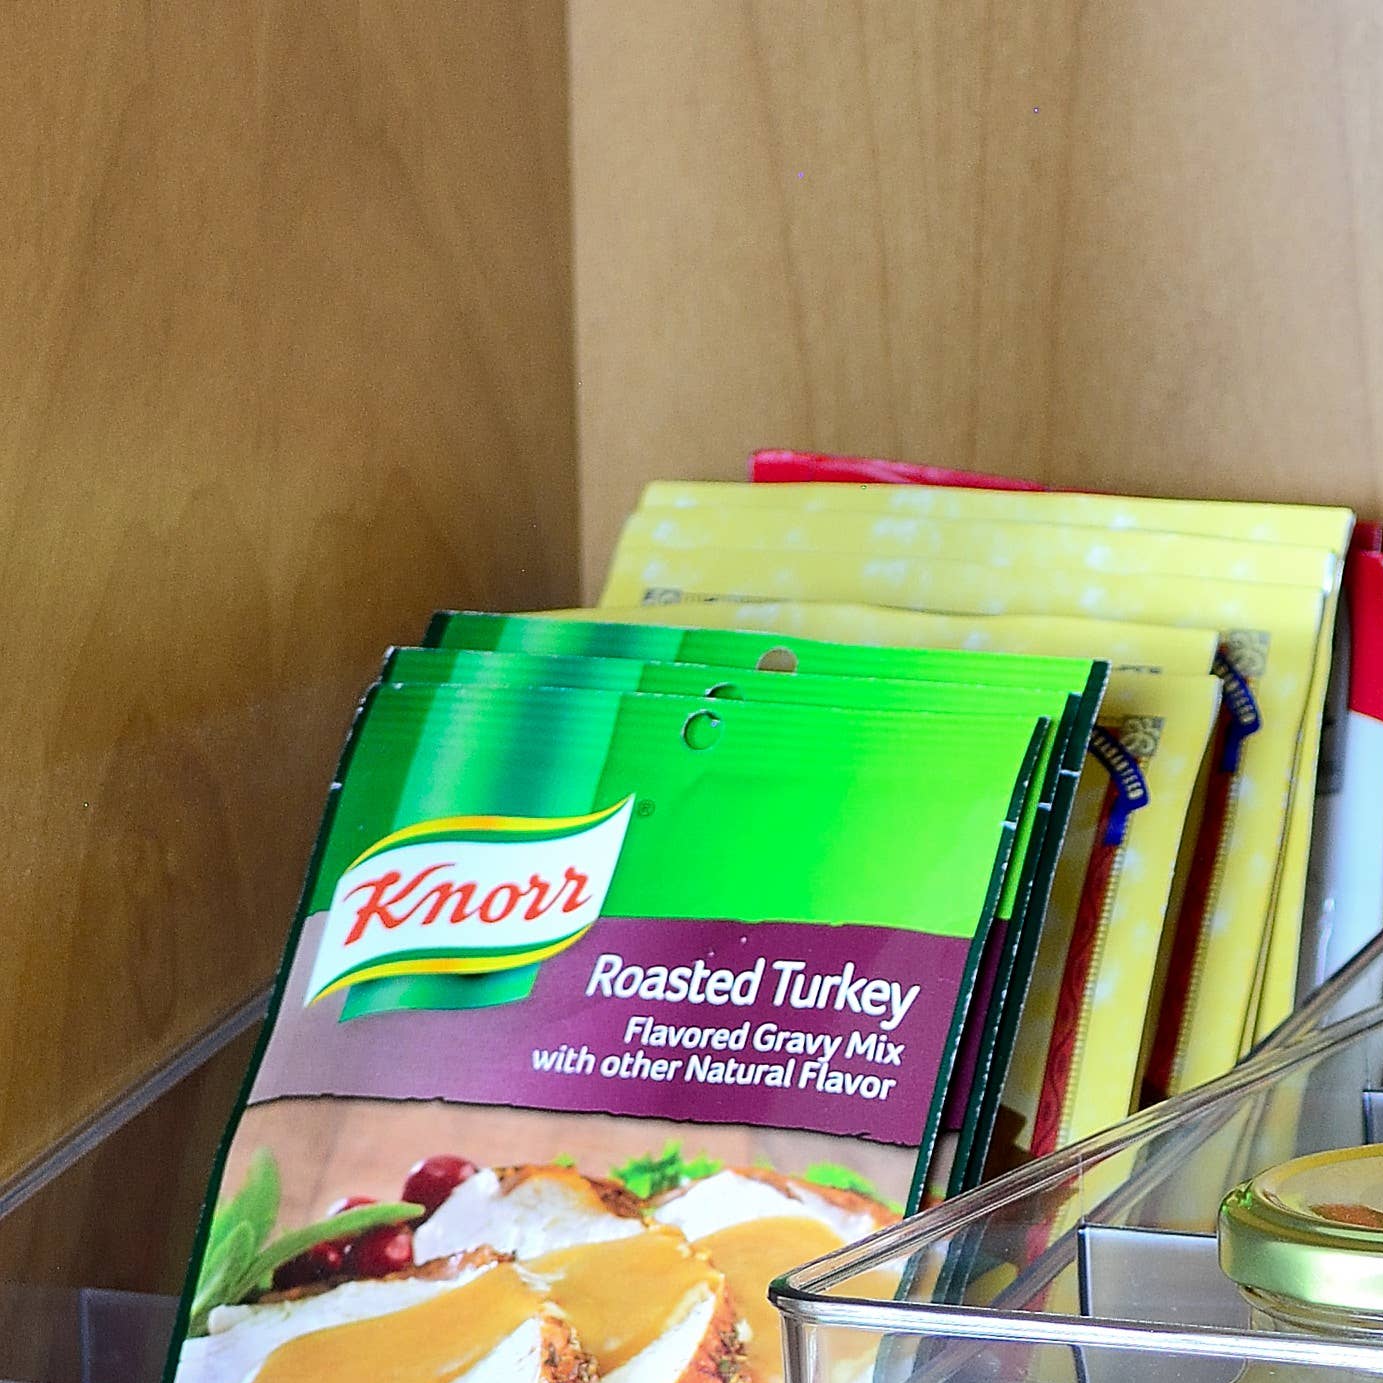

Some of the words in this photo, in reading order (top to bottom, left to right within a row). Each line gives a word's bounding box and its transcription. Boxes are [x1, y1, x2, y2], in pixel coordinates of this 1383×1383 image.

[341, 862, 594, 947] Knorr
[585, 953, 766, 1006] Roasted
[772, 959, 921, 1031] Turkey
[531, 1044, 596, 1075] with
[600, 1050, 683, 1081] other
[684, 1055, 796, 1088] Natural
[798, 1060, 897, 1100] Flavor
[624, 1015, 751, 1051] Flavored
[753, 1022, 843, 1063] Gravy
[845, 1031, 905, 1066] Mix
